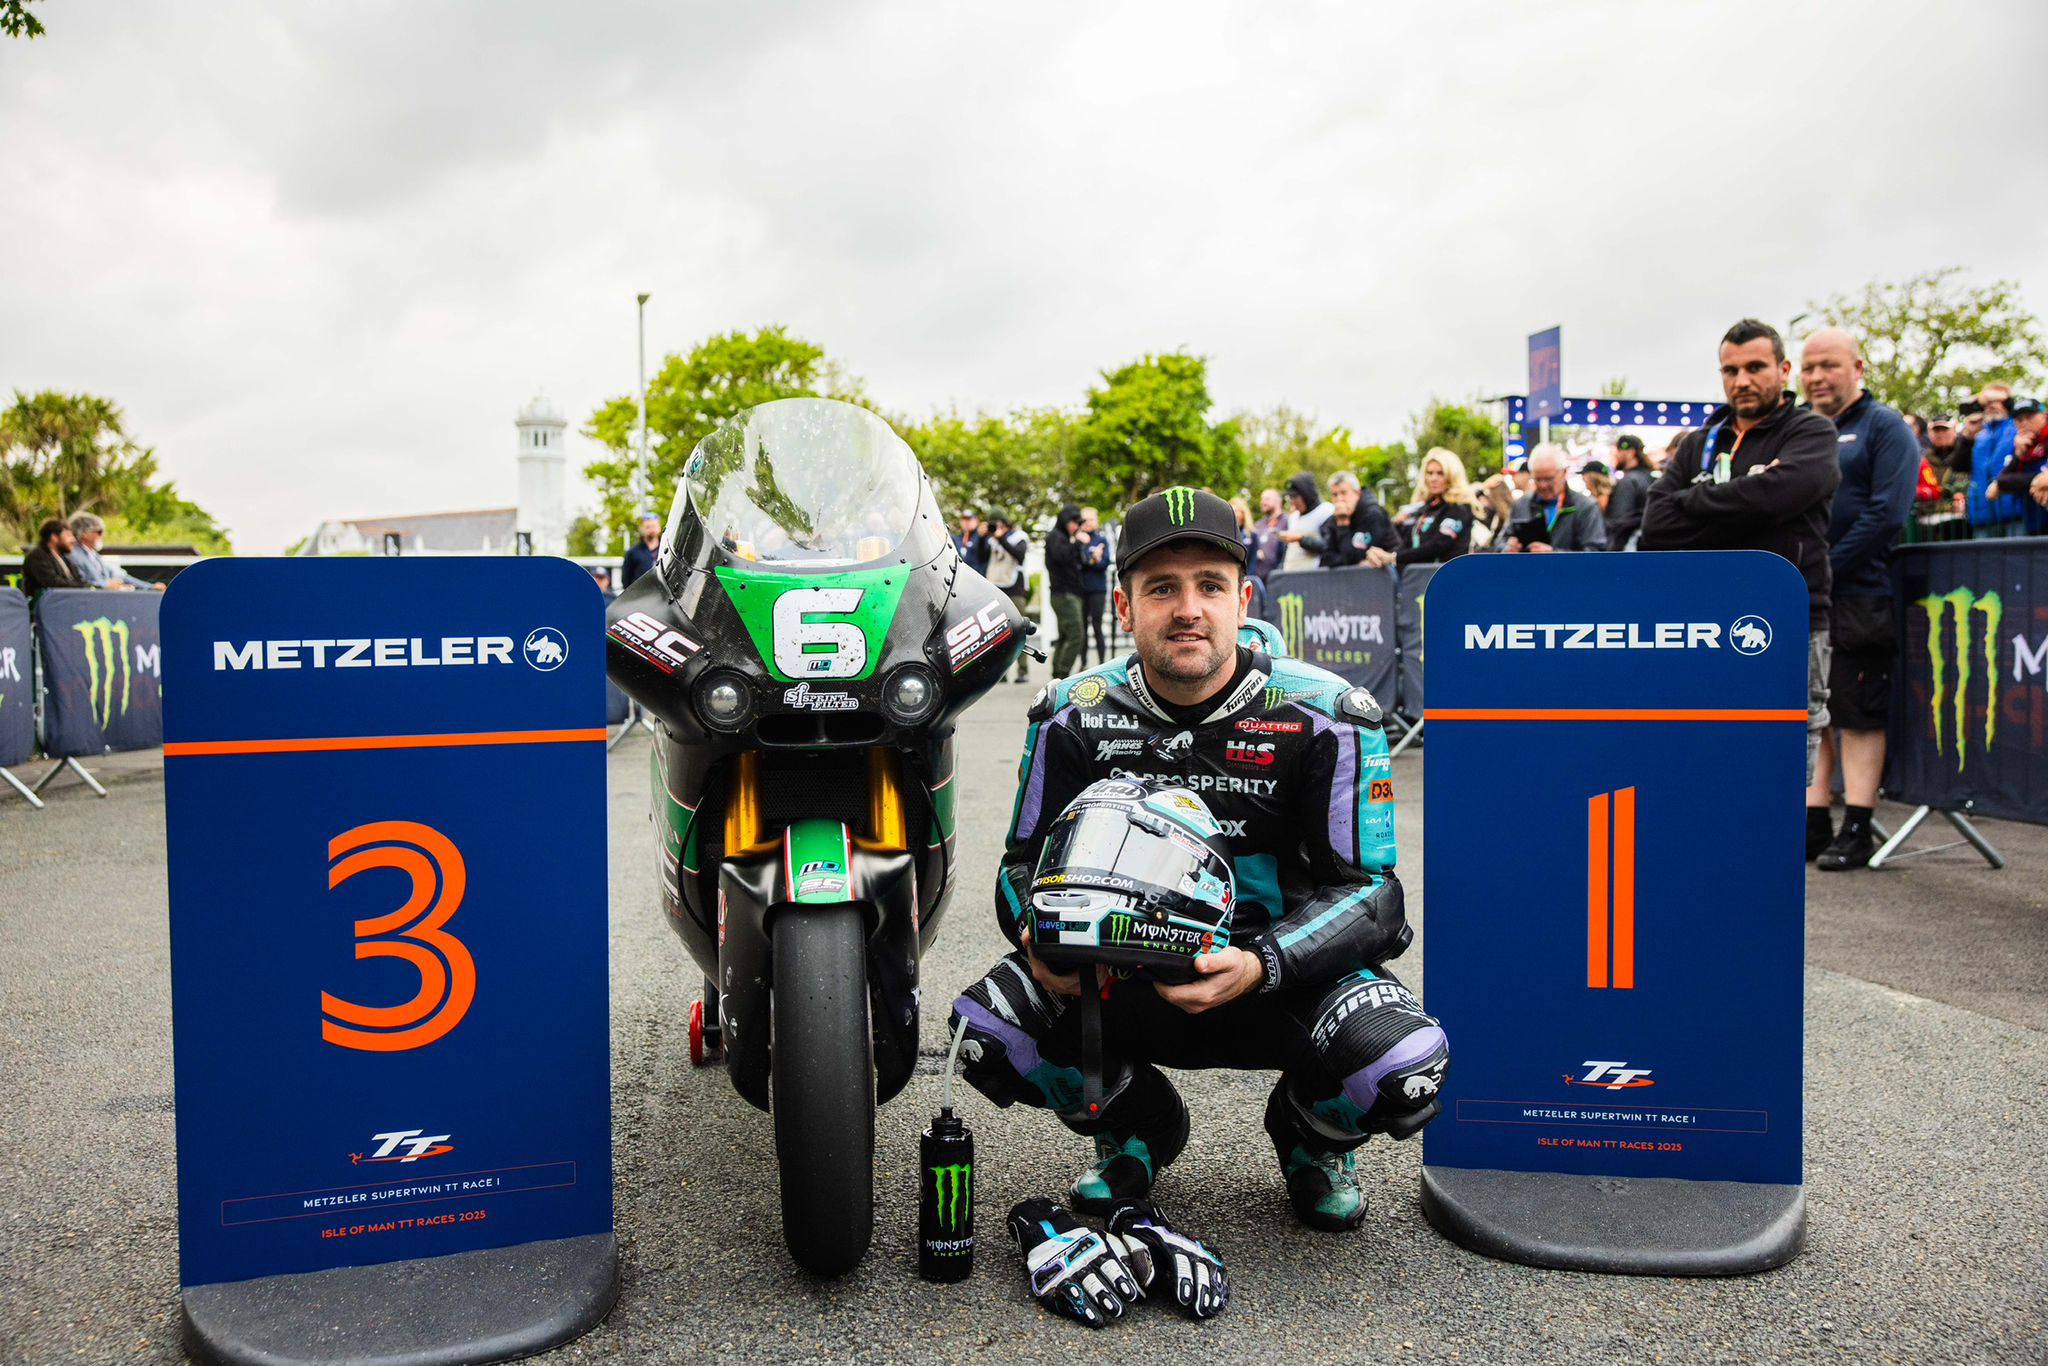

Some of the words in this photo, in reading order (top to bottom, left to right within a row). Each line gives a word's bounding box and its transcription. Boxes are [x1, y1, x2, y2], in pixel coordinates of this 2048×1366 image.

[617, 612, 703, 663] SC
[772, 587, 867, 679] 6
[946, 600, 1008, 658] SC
[1303, 611, 1384, 645] MONSTER
[1465, 622, 1722, 650] METZELER
[213, 636, 514, 671] METZELER
[610, 624, 681, 668] PROJECT
[951, 620, 1009, 666] PROJECT
[1316, 651, 1372, 665] ENERGY
[803, 692, 848, 702] SPRINT
[812, 700, 859, 710] FILTER
[1238, 720, 1300, 732] QUATTRO
[1226, 740, 1276, 766] H&S
[321, 820, 477, 1052] 3
[1038, 920, 1066, 931] GLOVER
[1133, 921, 1201, 946] MONSTER
[1143, 941, 1193, 953] ENERGY
[1523, 1109, 1577, 1119] METZELER
[1580, 1111, 1642, 1122] SUPERTWIN
[1645, 1114, 1658, 1122] TT
[1661, 1115, 1689, 1124] RACE
[1537, 1137, 1559, 1146] ISLE
[1561, 1138, 1576, 1147] OF
[1577, 1139, 1601, 1148] MAN
[1603, 1140, 1618, 1149] TT
[1620, 1141, 1655, 1150] RACES
[1657, 1142, 1683, 1152] 2025
[303, 1192, 368, 1209] METZELER
[371, 1184, 442, 1201] SUPERTWIN
[445, 1183, 459, 1193] TT
[462, 1178, 493, 1190] RACE
[321, 1226, 347, 1239] ISLE
[349, 1224, 366, 1236] OF
[368, 1221, 396, 1234] MAN
[398, 1219, 414, 1230] TT
[416, 1213, 456, 1227] RACES
[459, 1209, 487, 1222] 2025
[933, 1249, 971, 1257] ENERGY
